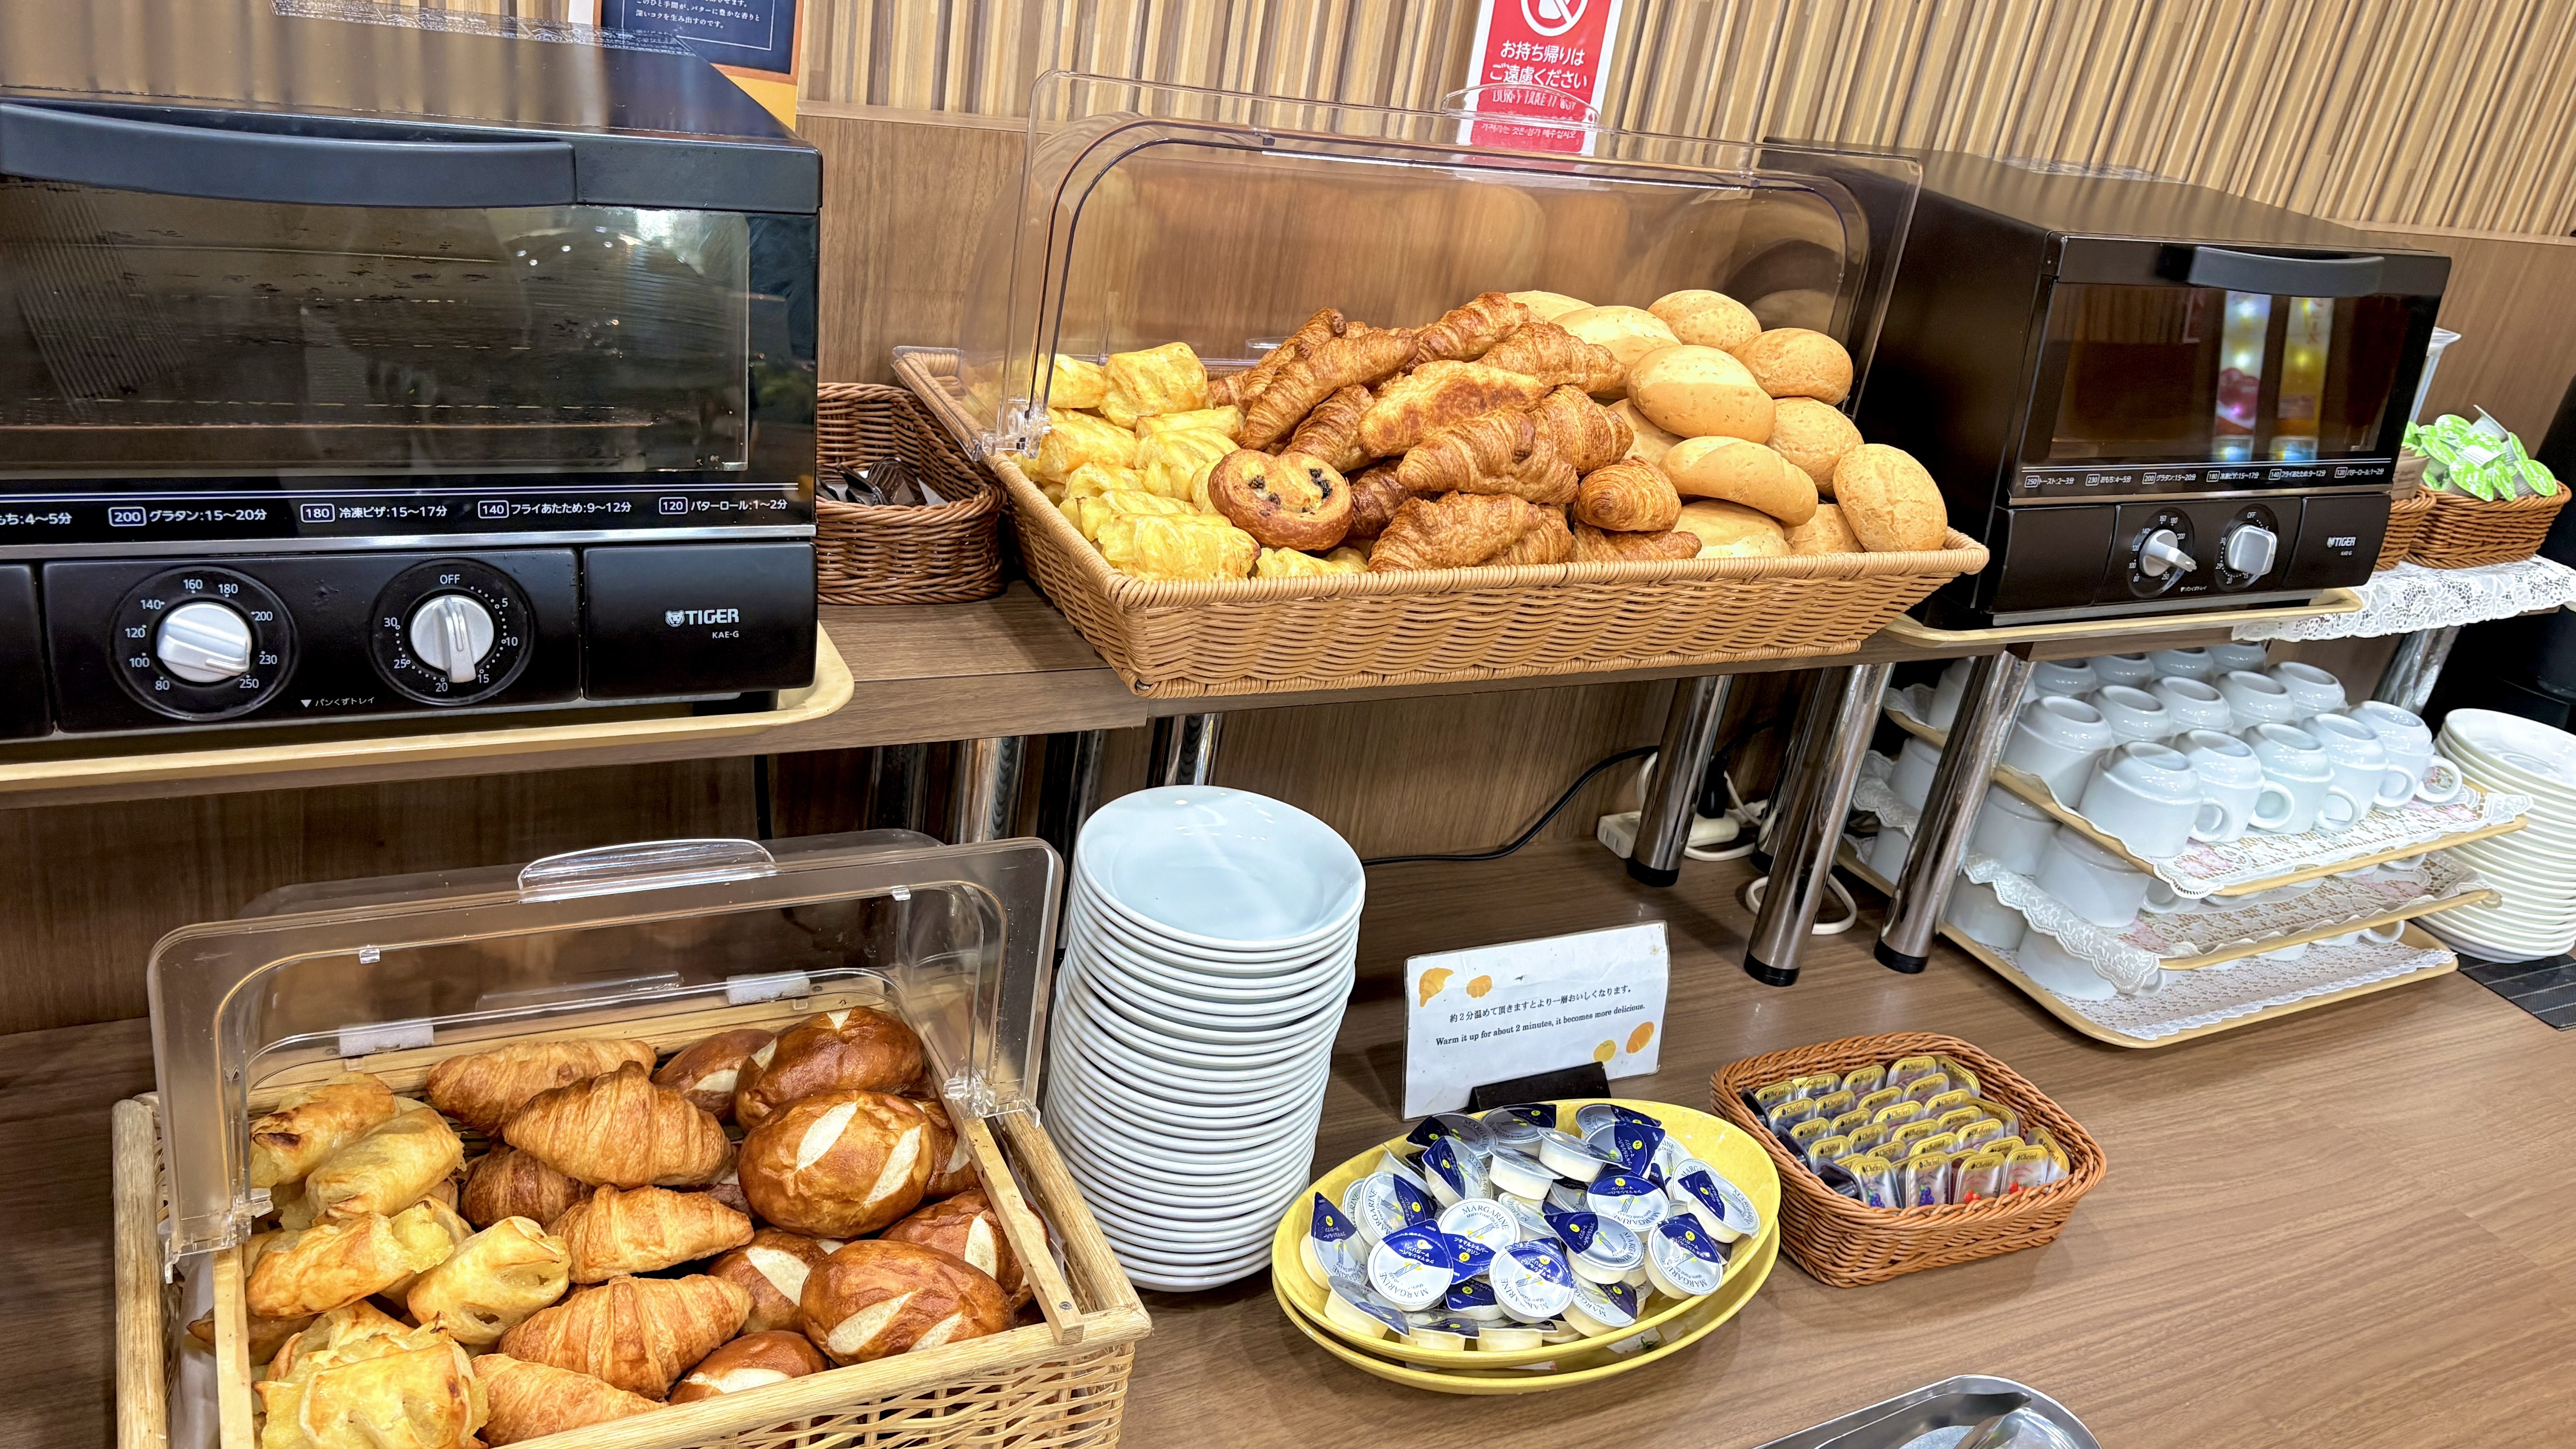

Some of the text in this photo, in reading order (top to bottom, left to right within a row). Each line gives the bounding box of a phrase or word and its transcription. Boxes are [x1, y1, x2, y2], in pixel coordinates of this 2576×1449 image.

[636, 9, 724, 29] 深いコクを生み出すのです。
[1500, 40, 1586, 66] お持ち帰りは
[1490, 63, 1587, 89] ご遠慮ください
[482, 505, 504, 515] 140
[663, 501, 683, 511] 120
[114, 512, 141, 522] 200
[306, 508, 330, 518] 180
[2334, 536, 2356, 547] TIGER
[183, 579, 203, 590] 160
[439, 574, 460, 584] OFF
[218, 583, 238, 594] 180
[140, 599, 162, 610] 140
[502, 597, 508, 607] 5
[254, 611, 273, 621] 200
[685, 608, 739, 625] TIGER
[384, 617, 397, 628] 30
[125, 627, 145, 638] 120
[712, 630, 739, 639] KAE-G
[506, 637, 518, 646] 10
[129, 657, 150, 667] 100
[259, 653, 278, 665] 230
[394, 658, 406, 669] 25
[239, 678, 259, 689] 250
[477, 672, 489, 684] 15
[155, 680, 170, 690] 80
[435, 680, 448, 692] 20
[315, 697, 374, 707] パンくずトレイ
[1450, 985, 1632, 1023] 約2分温めて頂きますとより一層おいしくなります。
[1436, 1037, 1459, 1045] Warm
[1481, 1030, 1491, 1039] for
[1493, 1026, 1514, 1036] about
[1522, 1020, 1554, 1031] minutes,
[1563, 1014, 1593, 1024] becomes
[1614, 1004, 1645, 1014] delicious.
[1462, 1205, 1509, 1230] MARGARINE
[1454, 1237, 1489, 1253] ツキマルシルバー
[1458, 1244, 1480, 1256] マーガリン
[1379, 1272, 1429, 1298] MARGARINE
